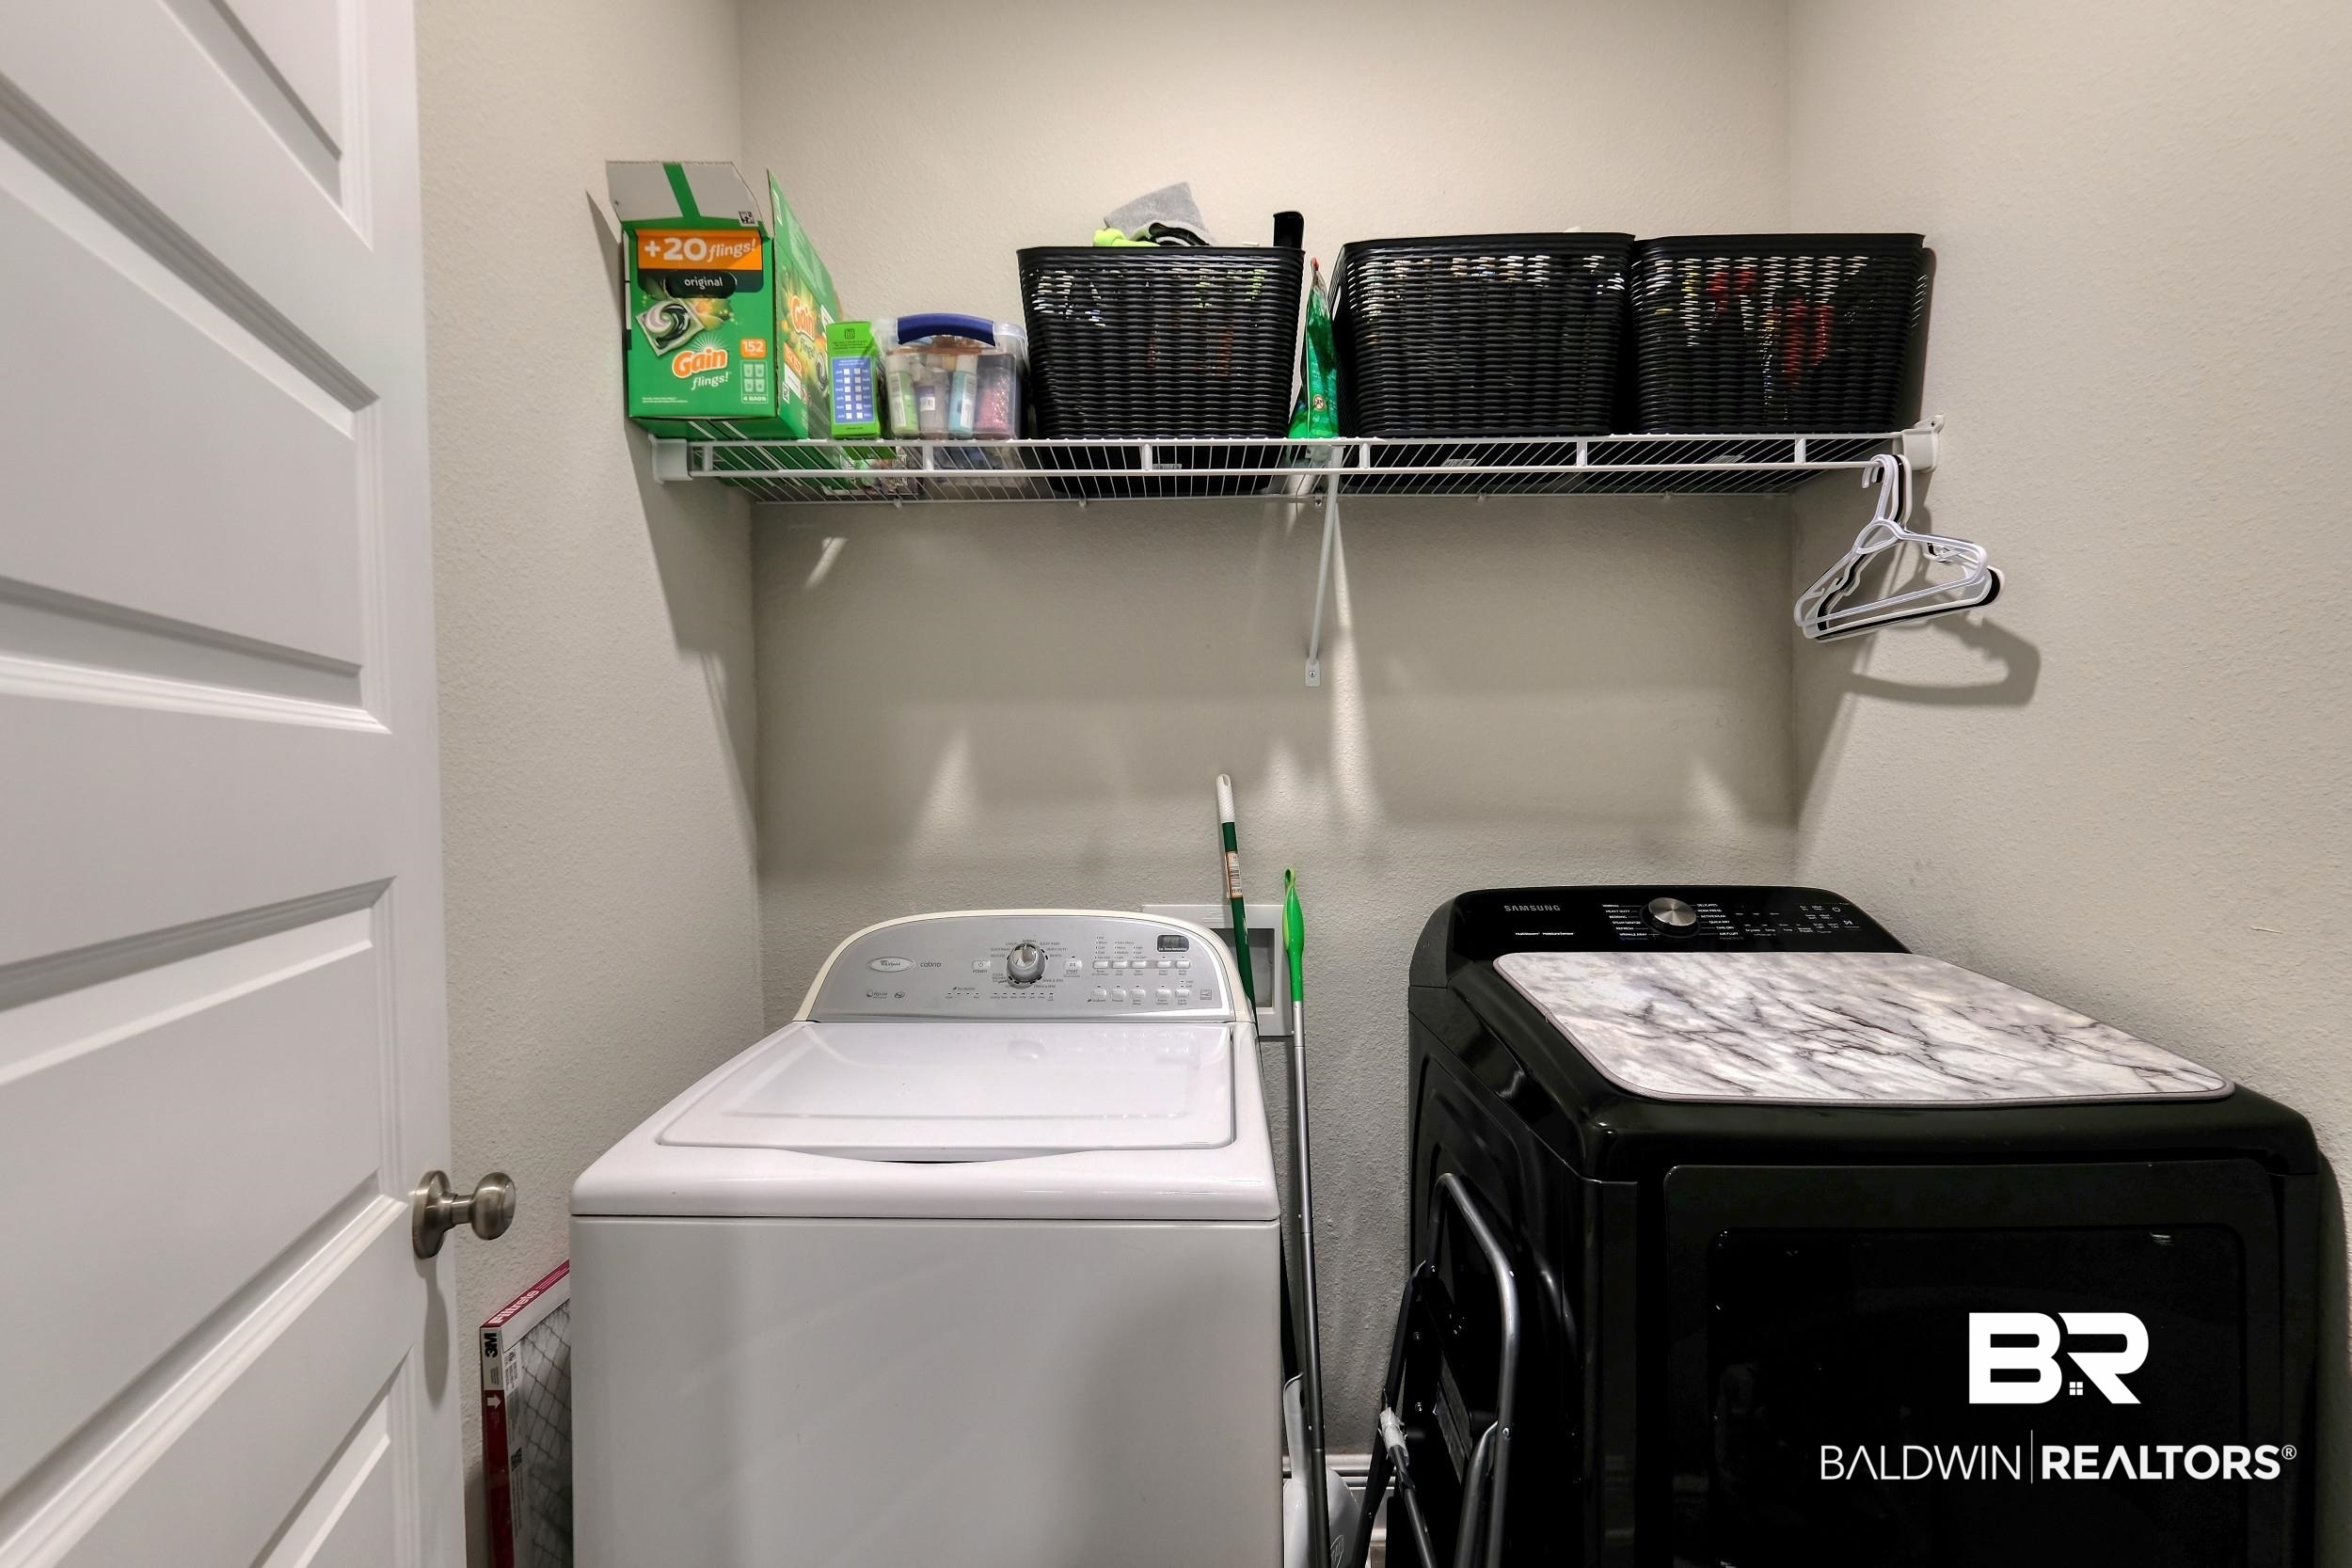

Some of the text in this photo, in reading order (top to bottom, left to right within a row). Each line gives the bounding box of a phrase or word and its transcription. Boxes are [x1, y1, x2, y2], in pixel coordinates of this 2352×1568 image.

[644, 237, 756, 262] +20 flings!
[684, 277, 723, 290] original
[790, 294, 815, 341] Gain
[742, 341, 765, 353] 152
[672, 346, 728, 379] Gain
[691, 371, 729, 391] flings!
[484, 1332, 499, 1358] 3M
